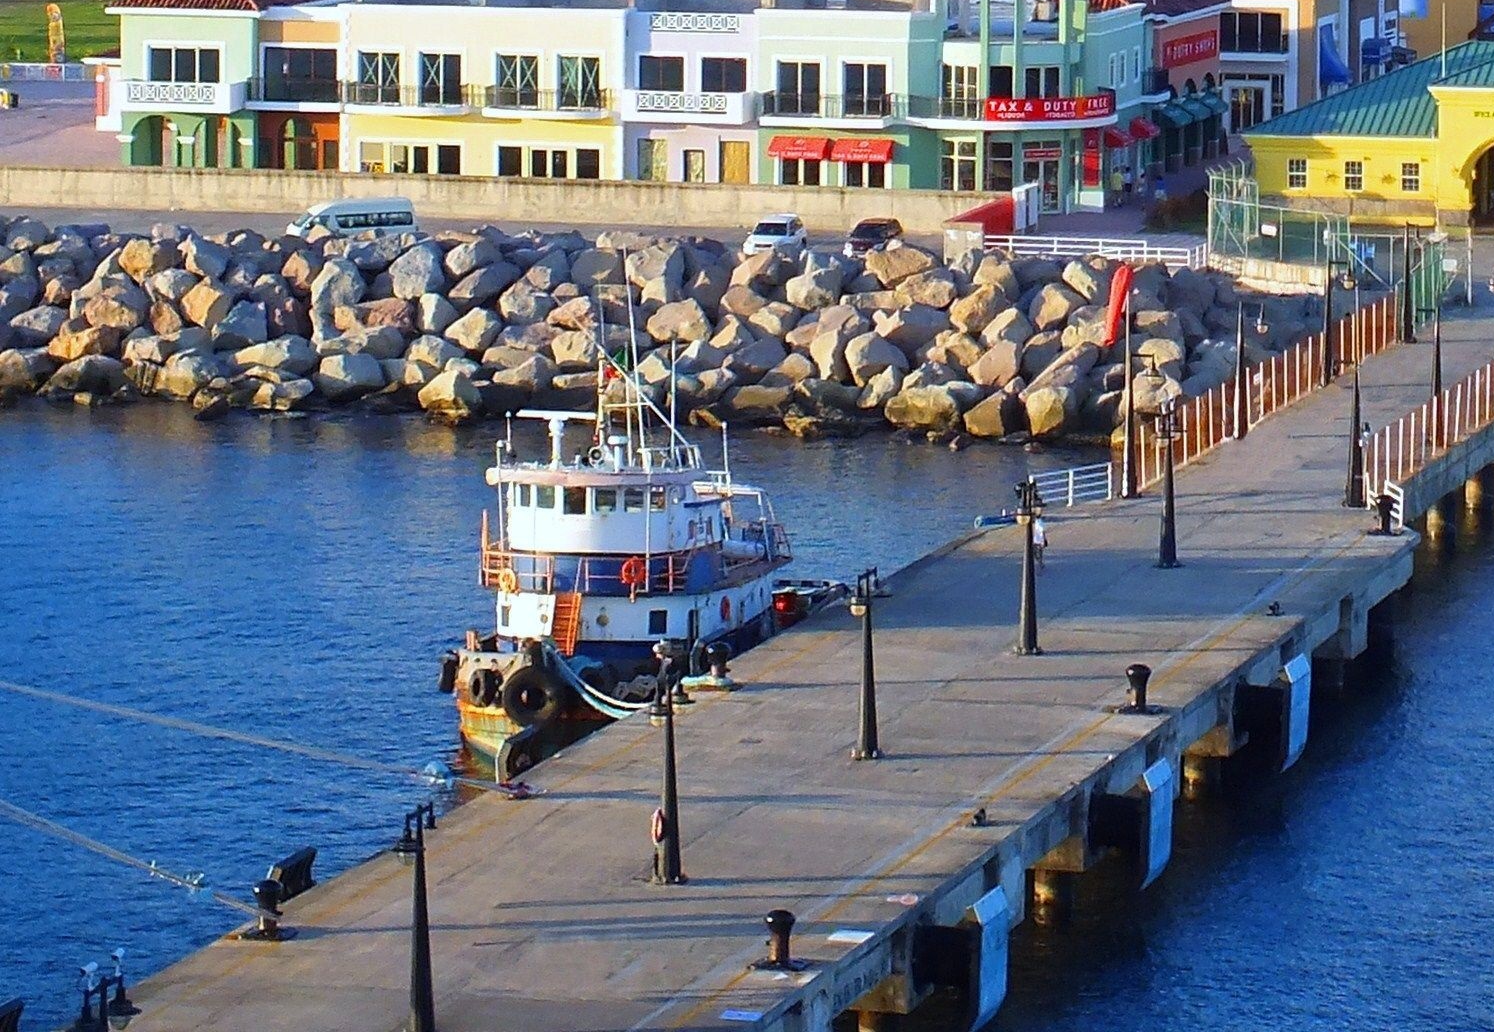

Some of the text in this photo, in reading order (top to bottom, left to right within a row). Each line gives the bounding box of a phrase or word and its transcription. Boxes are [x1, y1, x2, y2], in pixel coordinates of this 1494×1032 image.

[989, 96, 1108, 112] TAX & DUTY FREE
